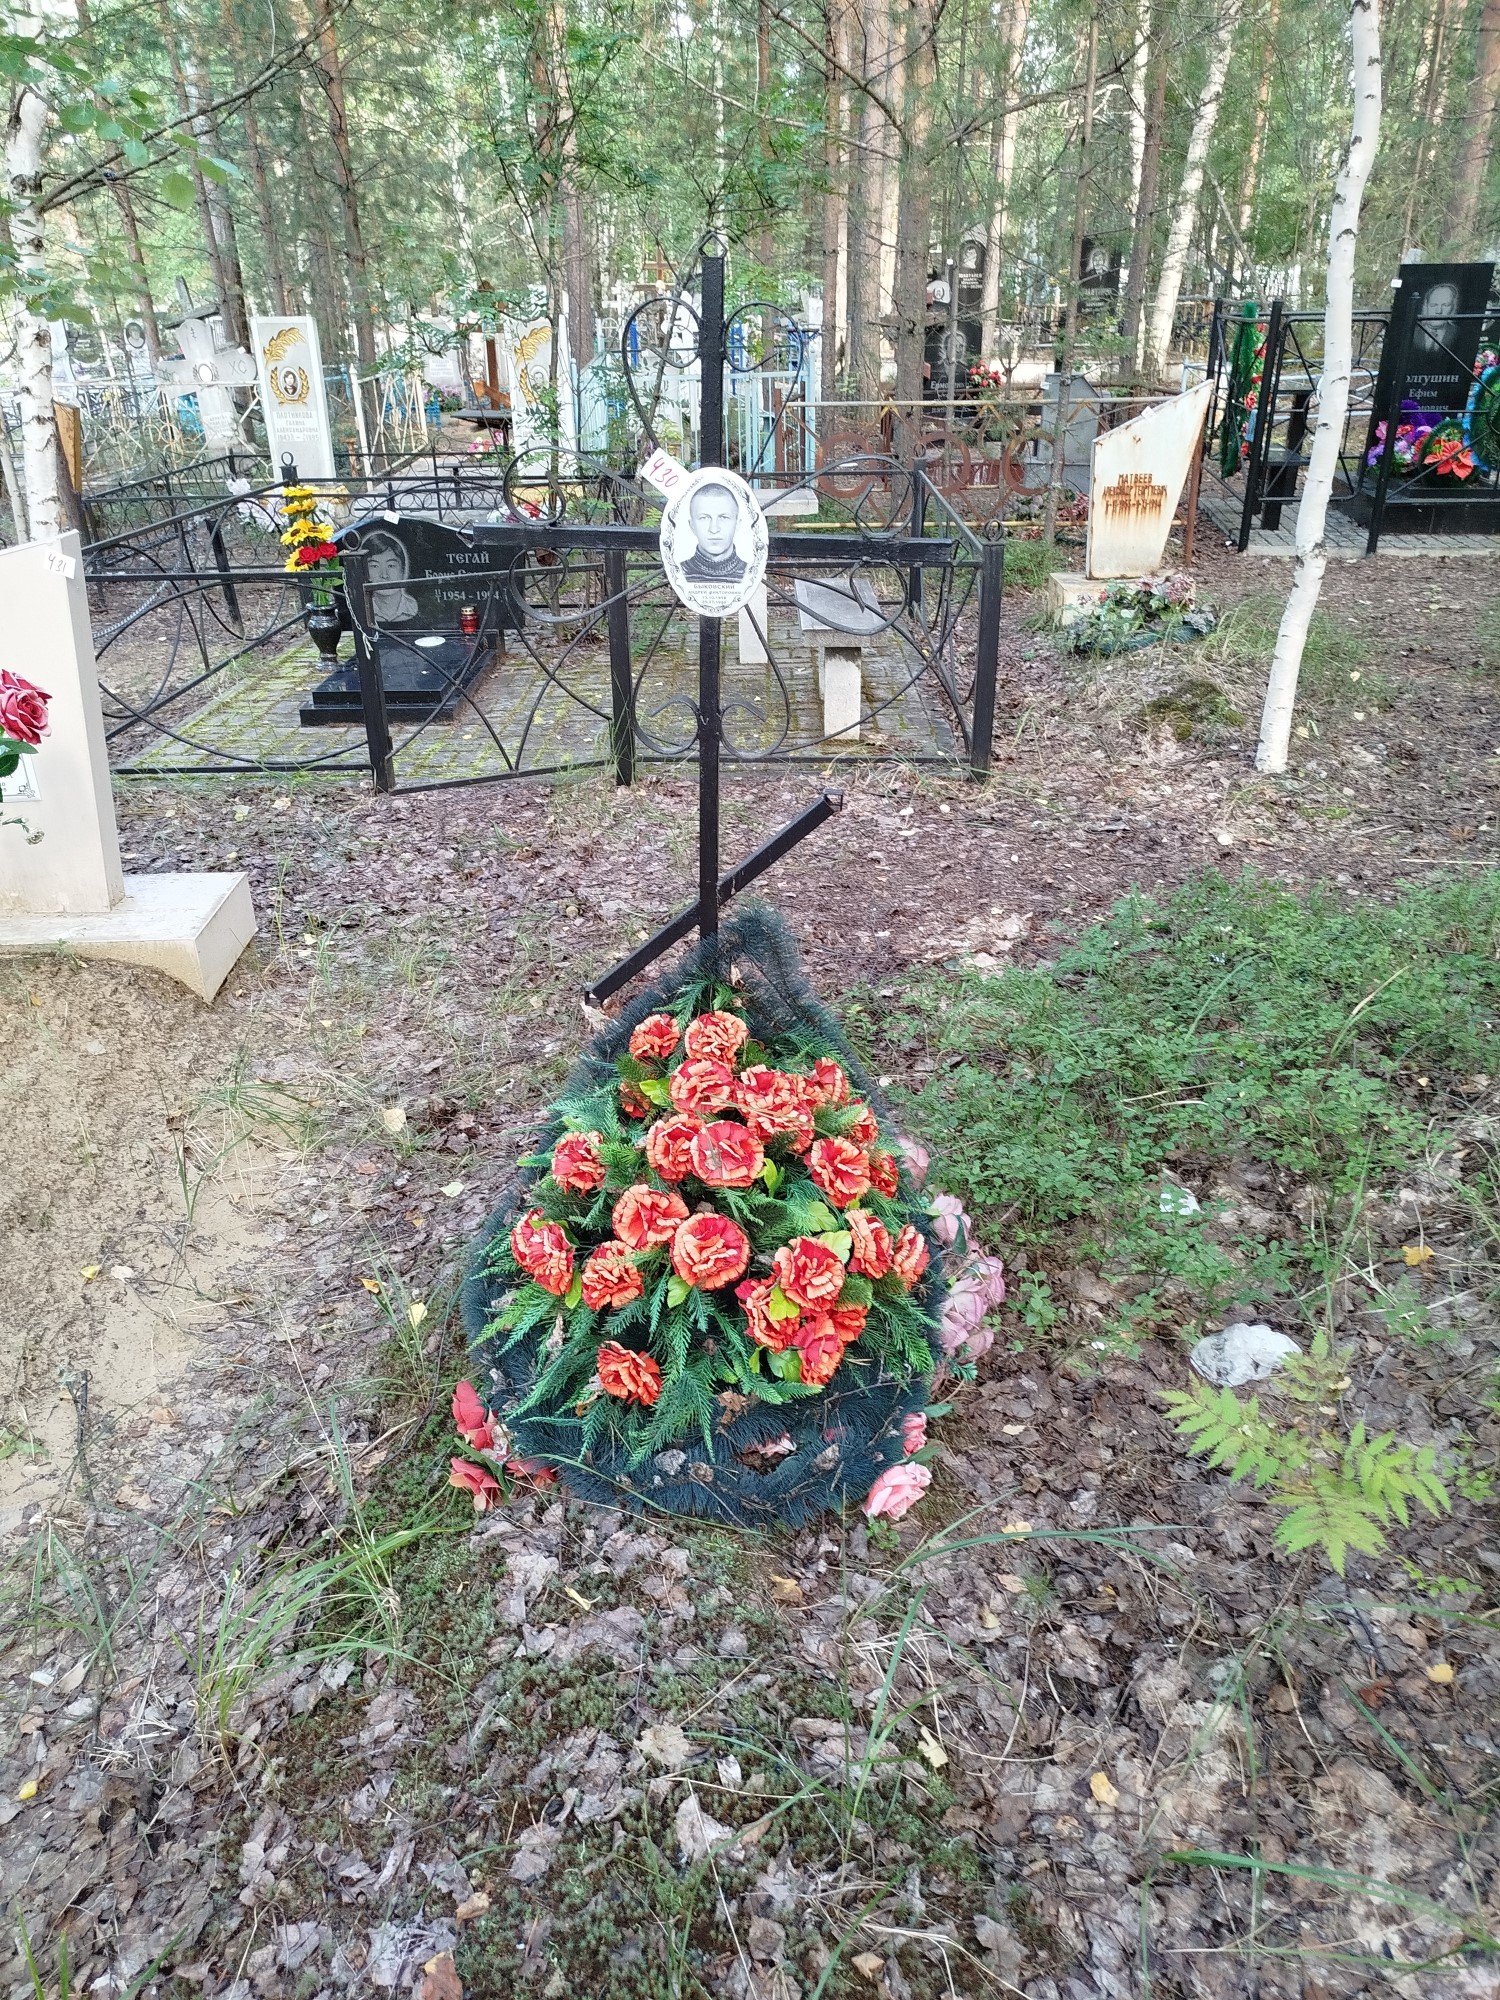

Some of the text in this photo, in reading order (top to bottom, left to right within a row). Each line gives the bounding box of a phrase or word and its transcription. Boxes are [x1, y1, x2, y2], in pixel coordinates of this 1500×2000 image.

[1408, 388, 1439, 400] Ефим
[649, 457, 680, 488] 430
[1117, 473, 1153, 485] МАТВЕЕВ
[48, 553, 67, 573] 431
[445, 551, 491, 564] ТЕГАЙ
[442, 590, 466, 601] 1954
